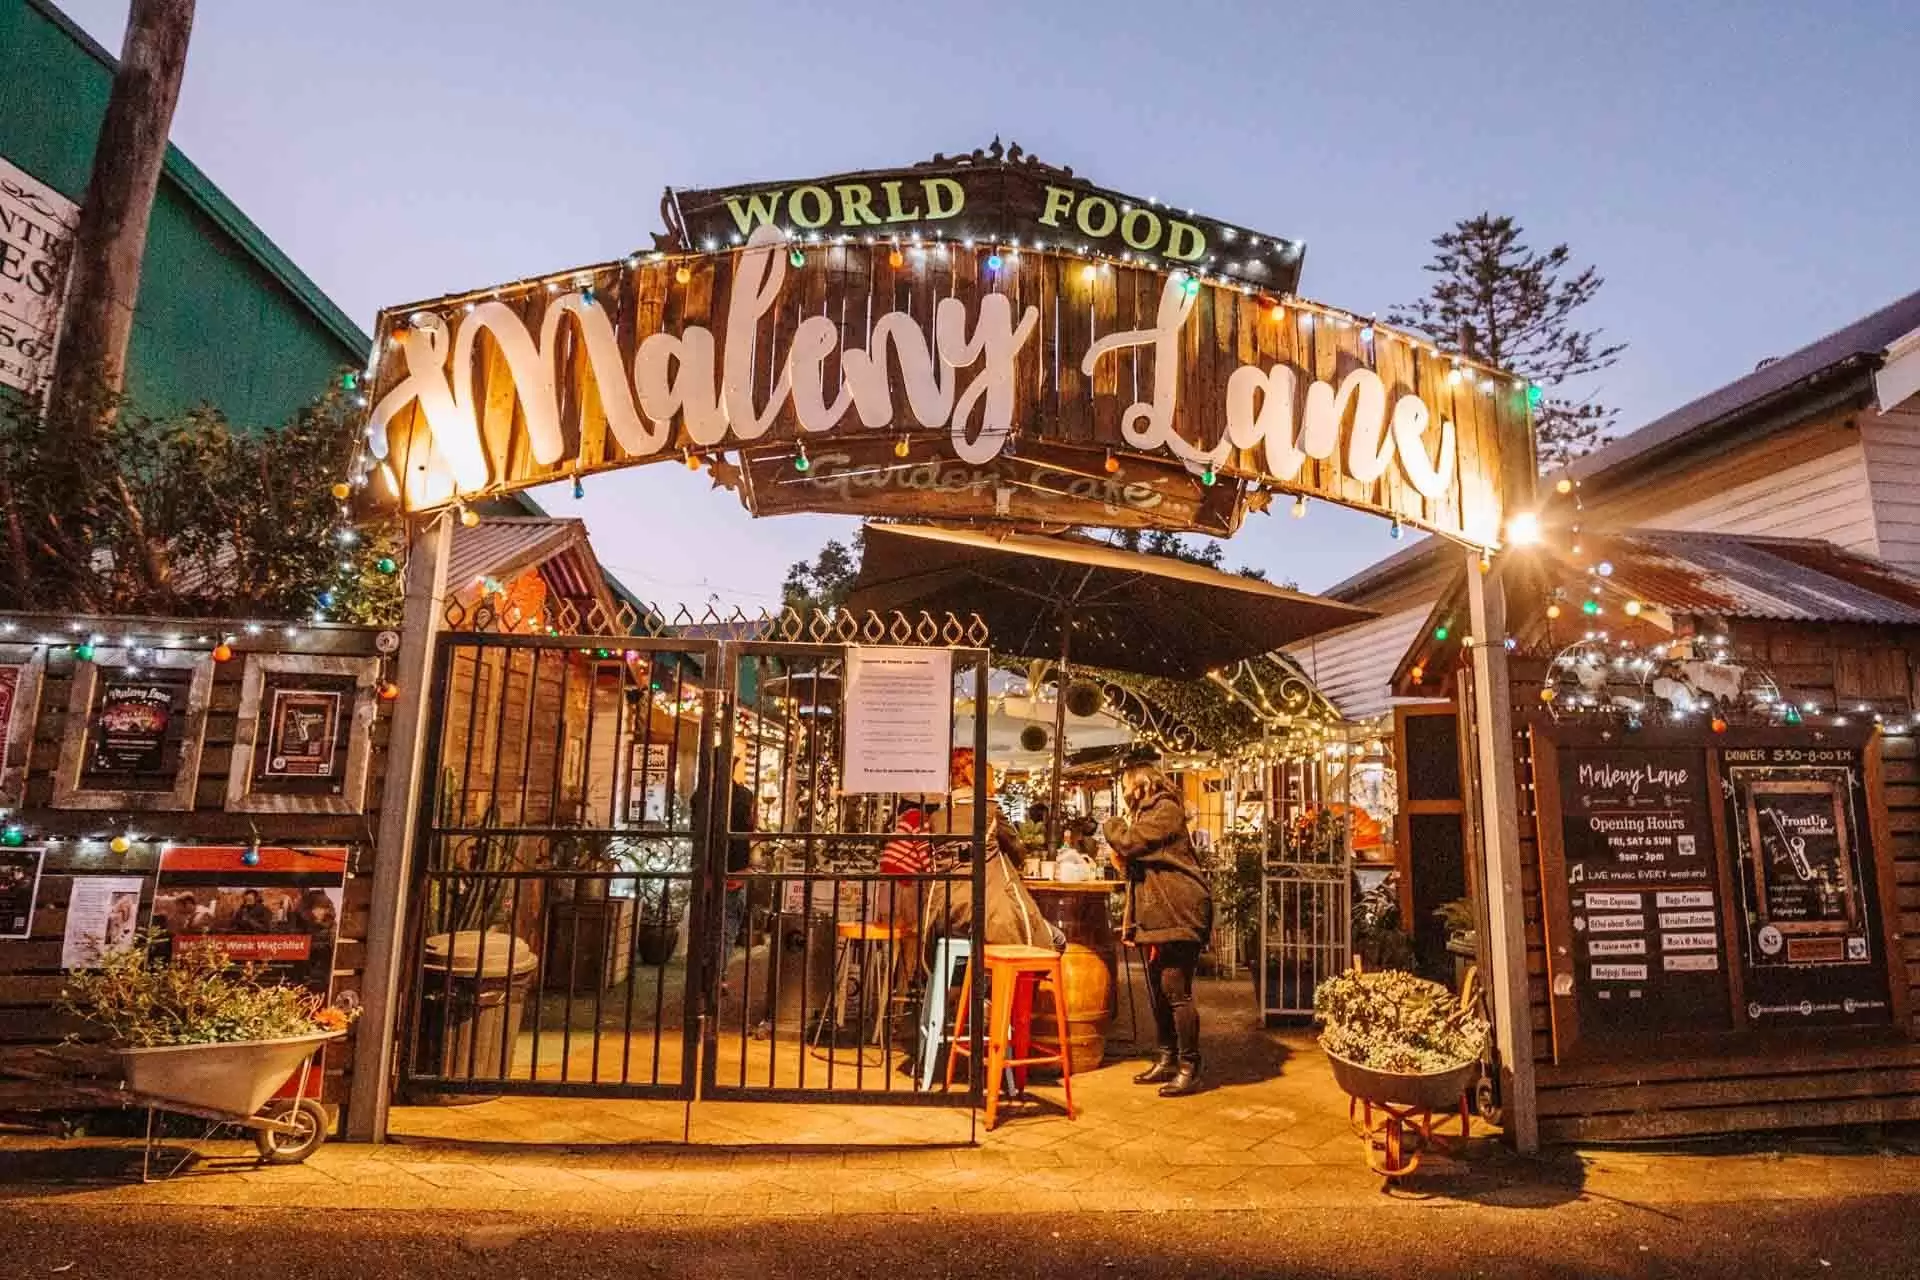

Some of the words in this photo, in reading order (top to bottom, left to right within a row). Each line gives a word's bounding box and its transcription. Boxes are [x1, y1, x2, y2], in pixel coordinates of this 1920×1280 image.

[727, 177, 966, 238] WORLD
[1038, 185, 1207, 262] FOOD
[369, 224, 1040, 492] Maleny
[1081, 270, 1455, 499] Lane
[809, 453, 1012, 500] Garden
[1725, 751, 1766, 761] DINNER
[1579, 763, 1645, 794] Maleny
[1646, 763, 1689, 788] Lane
[1590, 816, 1645, 833] Opening
[1646, 816, 1685, 830] Hours
[1626, 837, 1645, 846] SAT
[1653, 837, 1672, 846] SUN
[1588, 871, 1609, 880] LIVE
[1638, 870, 1667, 879] EVERY
[257, 940, 305, 952] Watchlist
